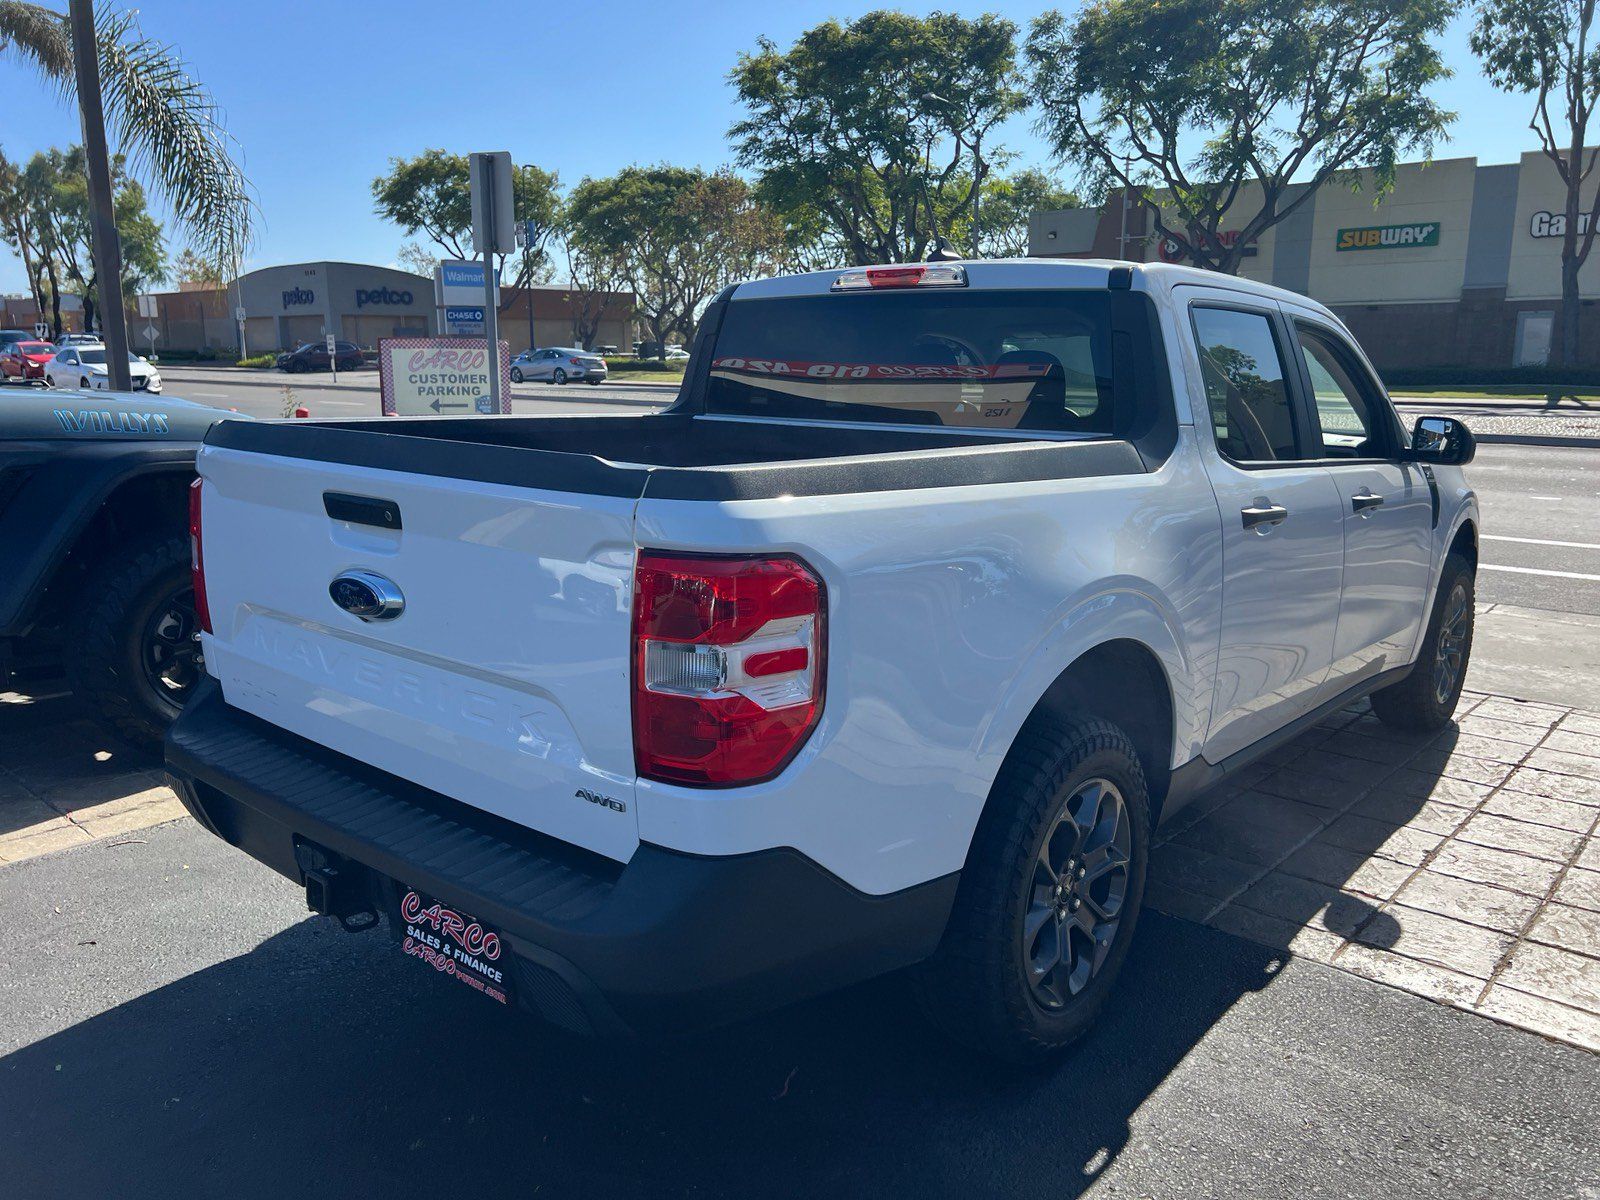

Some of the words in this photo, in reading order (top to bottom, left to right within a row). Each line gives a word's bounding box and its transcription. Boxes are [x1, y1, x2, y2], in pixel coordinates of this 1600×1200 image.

[1340, 224, 1435, 248] SUBWAY
[282, 286, 314, 310] petco
[355, 286, 413, 309] petco
[408, 350, 485, 372] CARCO
[408, 374, 488, 384] CUSTOMER
[417, 386, 481, 396] PARKING
[53, 409, 169, 434] WILLYS
[574, 788, 627, 813] AWD
[401, 891, 501, 961] CARCO
[406, 925, 441, 950] SALES
[442, 943, 452, 955] &
[453, 948, 503, 984] FINANCE
